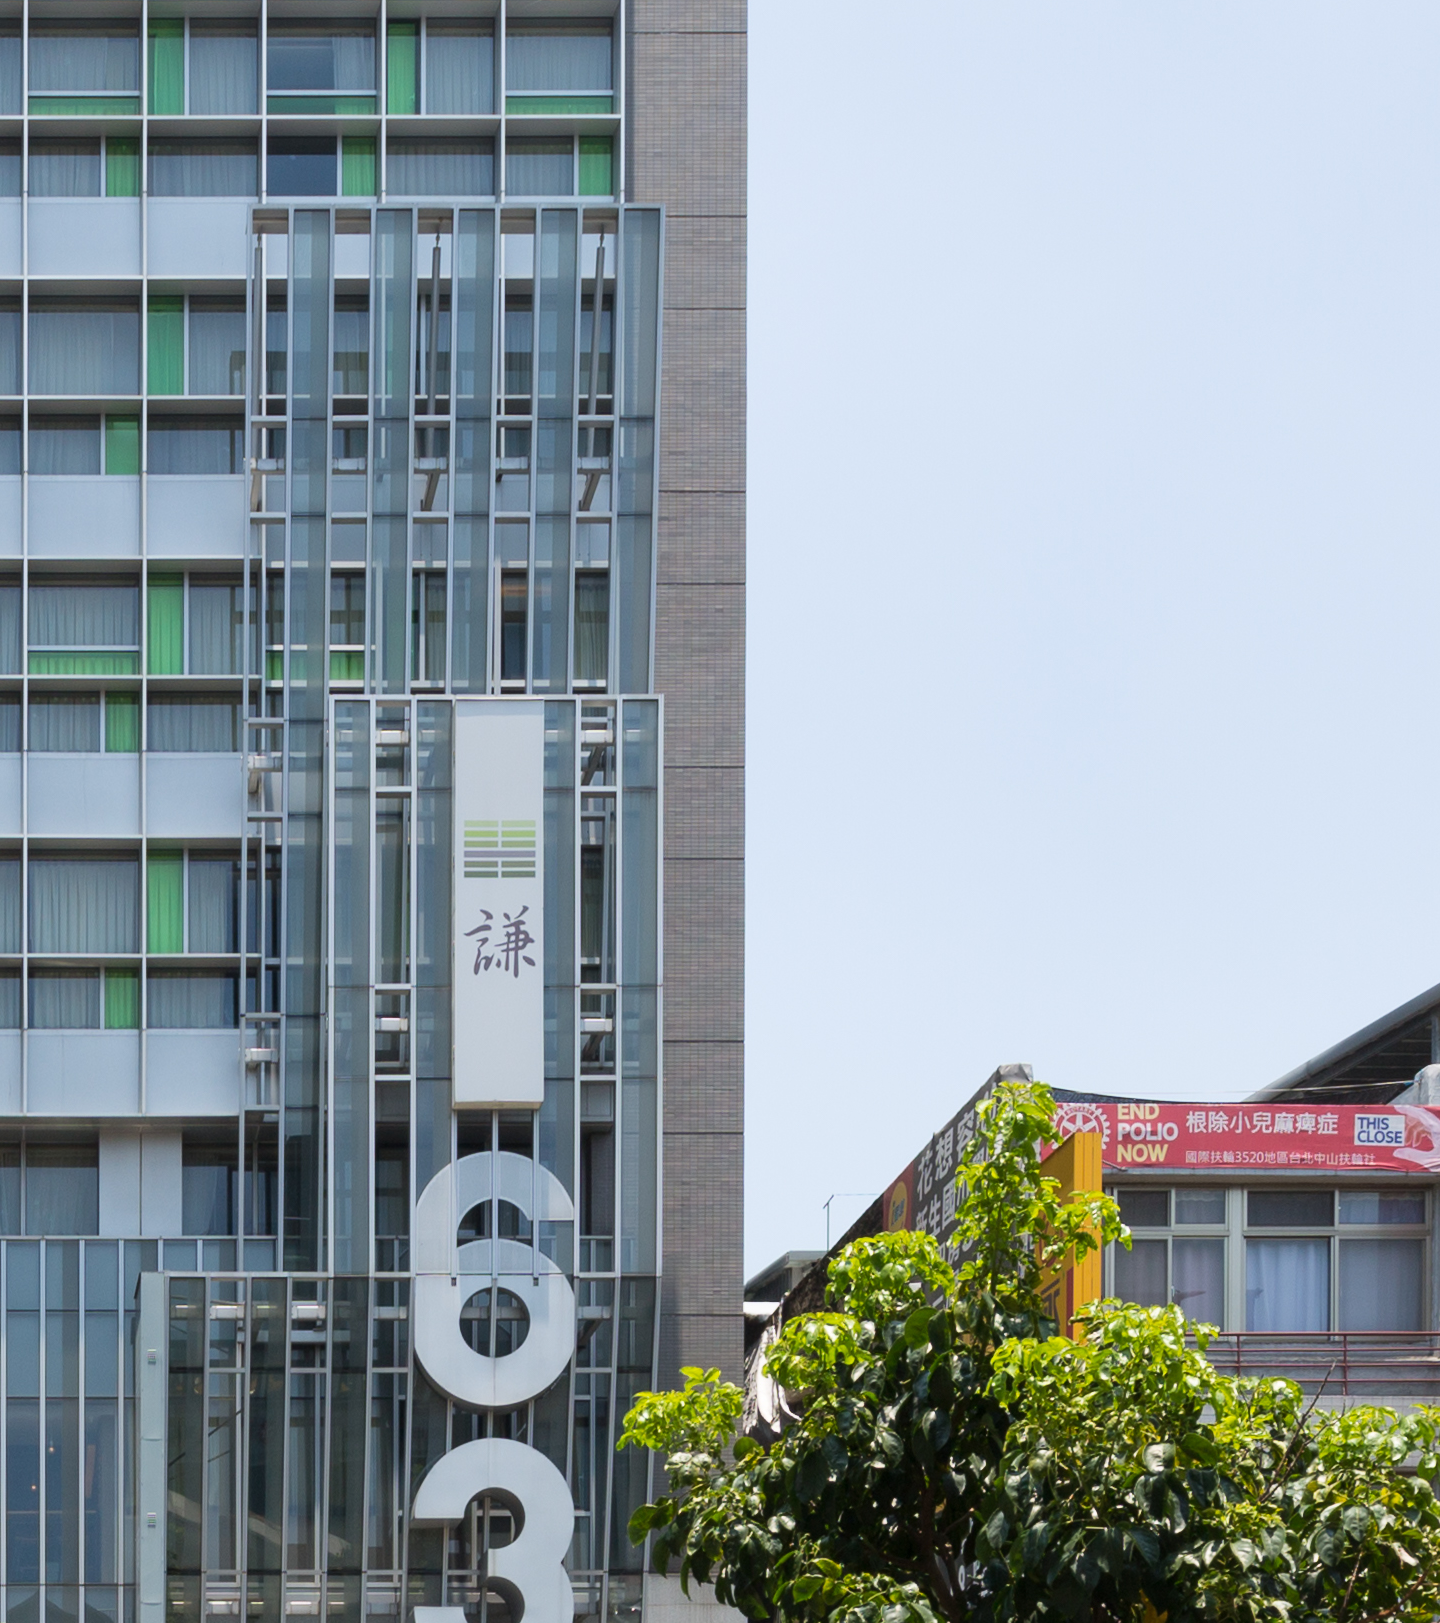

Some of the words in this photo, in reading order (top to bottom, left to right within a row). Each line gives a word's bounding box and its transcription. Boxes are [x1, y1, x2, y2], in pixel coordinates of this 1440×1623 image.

[1117, 1103, 1159, 1120] END
[1185, 1111, 1339, 1135] 根除小兒麻痺症
[1357, 1117, 1388, 1131] THIS
[1117, 1122, 1179, 1142] POLIO
[1357, 1130, 1404, 1145] CLOSE
[1117, 1144, 1169, 1162] NOW
